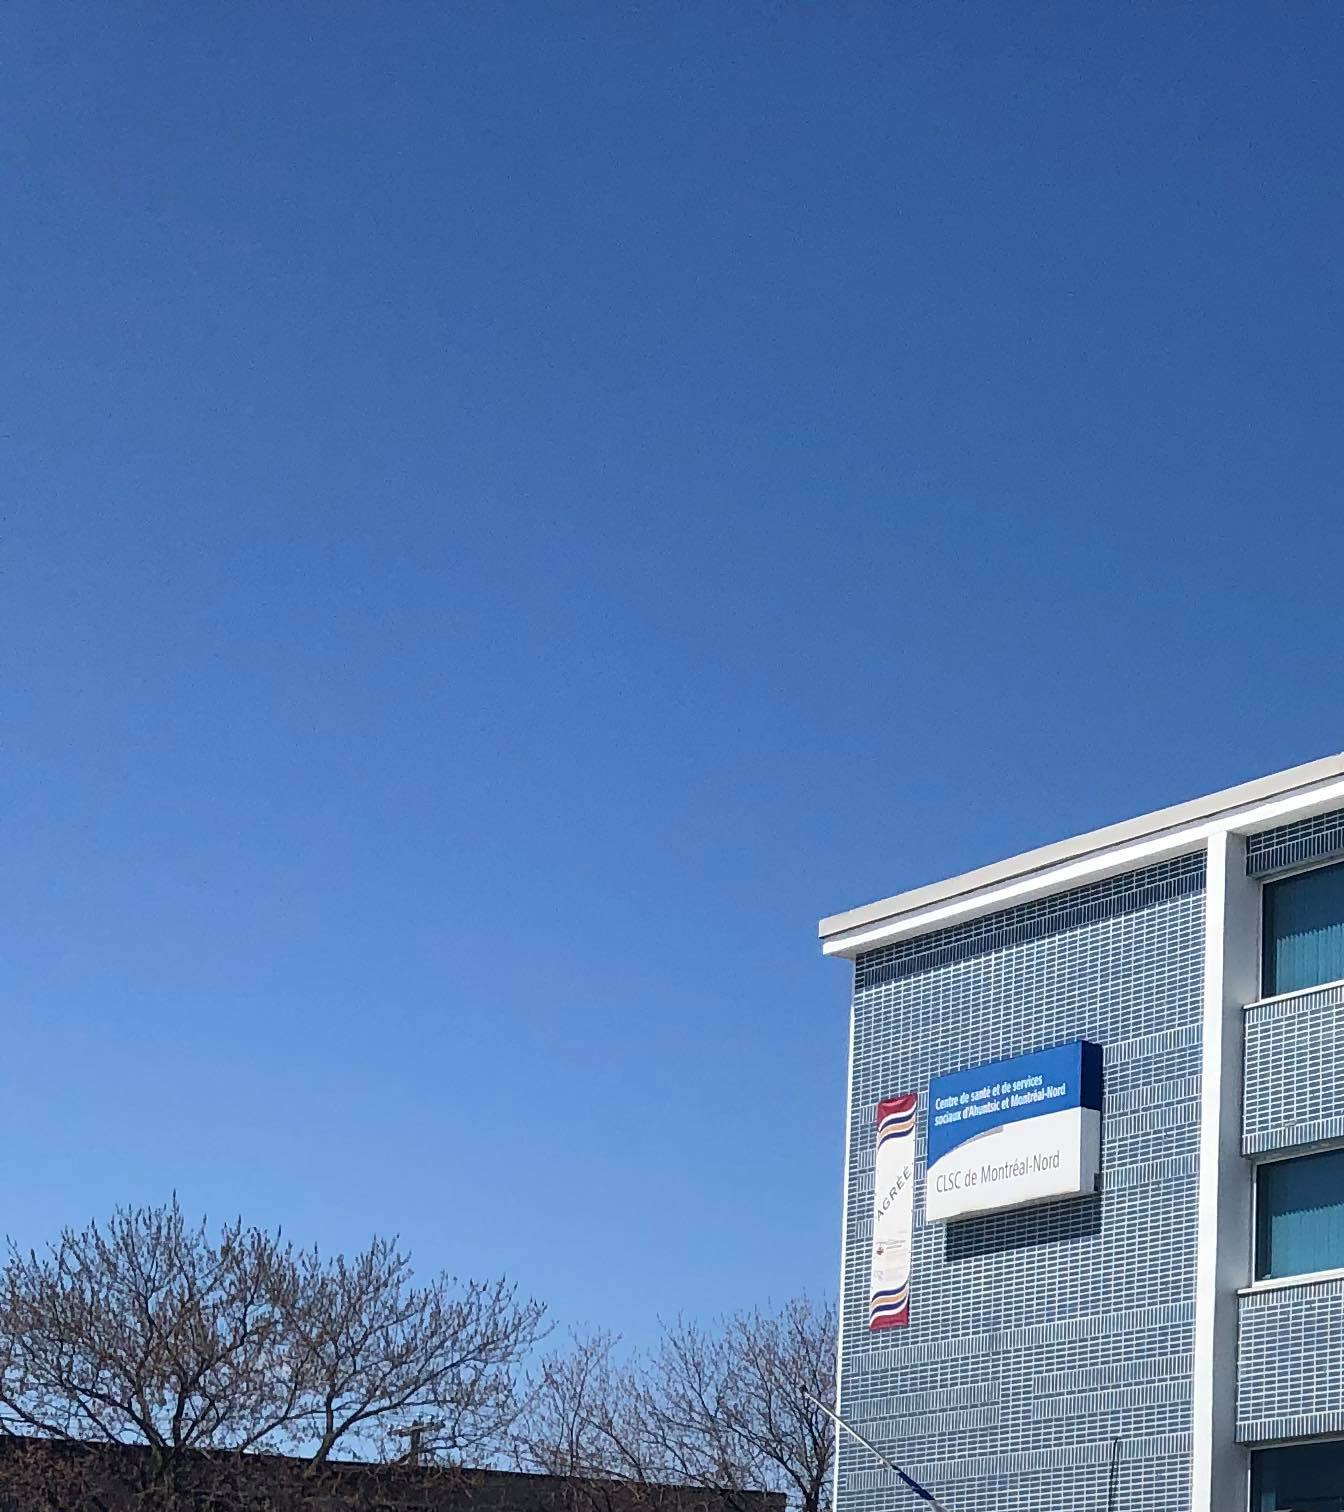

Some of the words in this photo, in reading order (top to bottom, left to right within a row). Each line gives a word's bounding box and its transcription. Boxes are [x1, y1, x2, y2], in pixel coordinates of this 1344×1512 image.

[934, 1110, 962, 1126] sociaux
[1001, 1097, 1010, 1110] et
[1010, 1082, 1067, 1107] Montréal-Nord
[935, 1096, 959, 1111] Centre
[960, 1092, 970, 1105] de
[971, 1086, 991, 1102] santé
[992, 1084, 1001, 1096] et
[1001, 1082, 1012, 1093] de
[1012, 1075, 1043, 1091] services
[936, 1170, 961, 1193] CLSC
[964, 1169, 978, 1187] de
[980, 1150, 1060, 1184] Montréal-Nord
